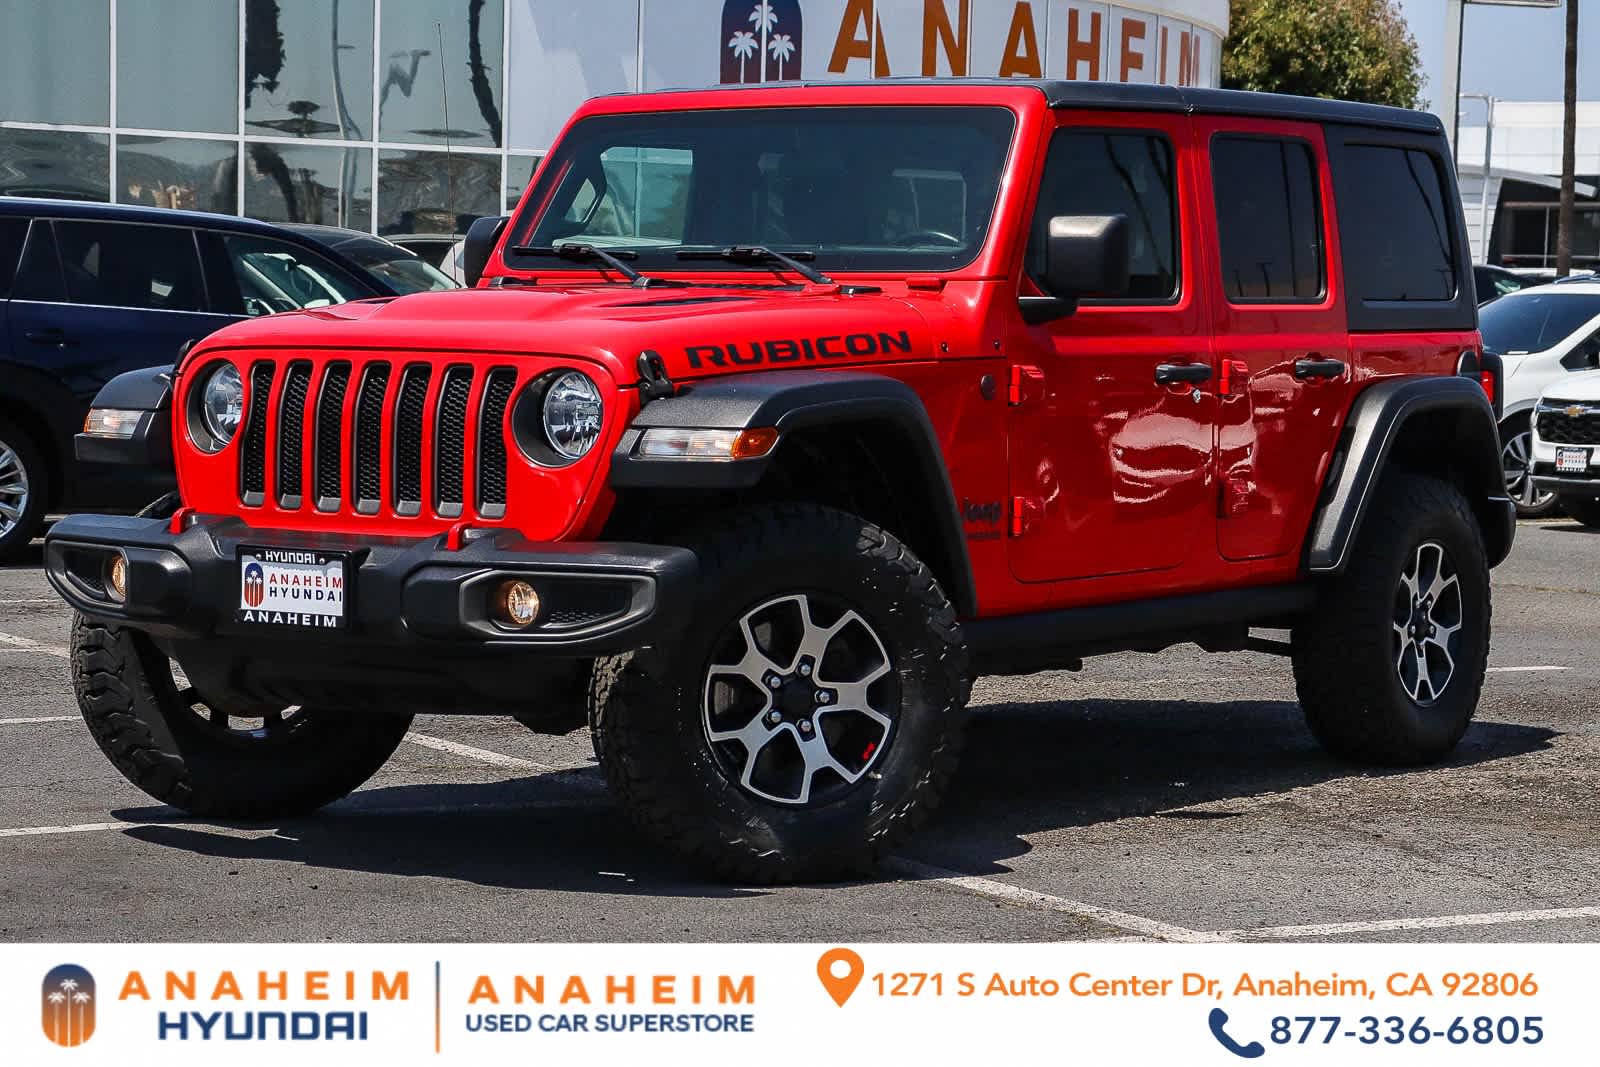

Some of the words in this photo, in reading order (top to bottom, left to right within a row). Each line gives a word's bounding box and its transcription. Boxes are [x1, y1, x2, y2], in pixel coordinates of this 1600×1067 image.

[827, 0, 1200, 86] ANAHEIM
[684, 330, 912, 369] RUBICON
[265, 551, 316, 564] HYUNDAI
[269, 573, 343, 589] ANAHEIM
[269, 587, 342, 602] HYUNDAI
[243, 610, 337, 628] ANAHEIM
